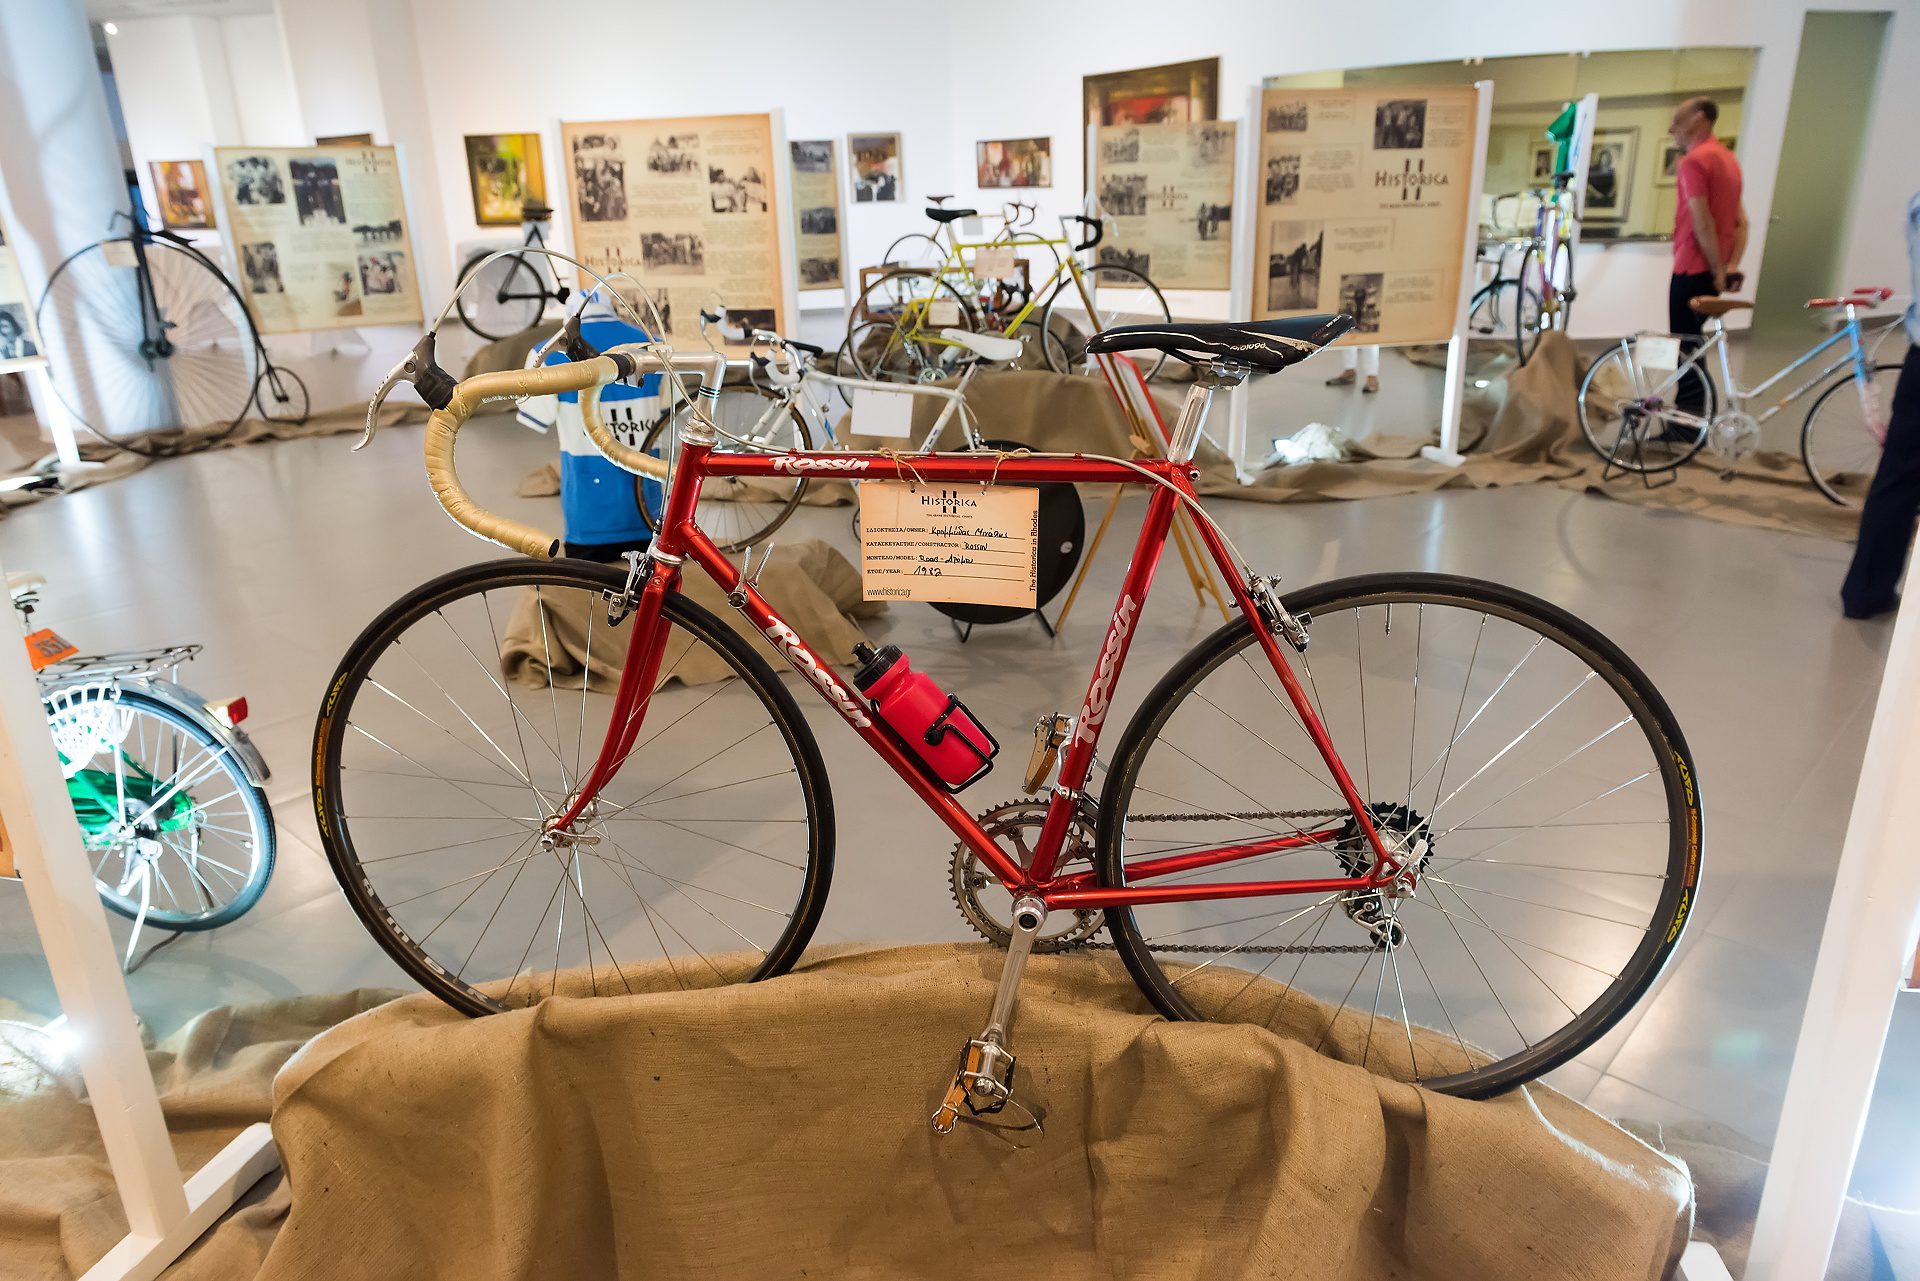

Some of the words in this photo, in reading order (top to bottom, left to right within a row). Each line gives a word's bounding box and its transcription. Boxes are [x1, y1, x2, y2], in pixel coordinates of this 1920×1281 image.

[769, 456, 870, 475] Rossin
[921, 495, 978, 507] HISTORICA
[1030, 510, 1038, 537] Rhodes
[1029, 546, 1037, 578] Historica
[766, 615, 872, 728] Rossin
[1074, 594, 1137, 749] Rossin
